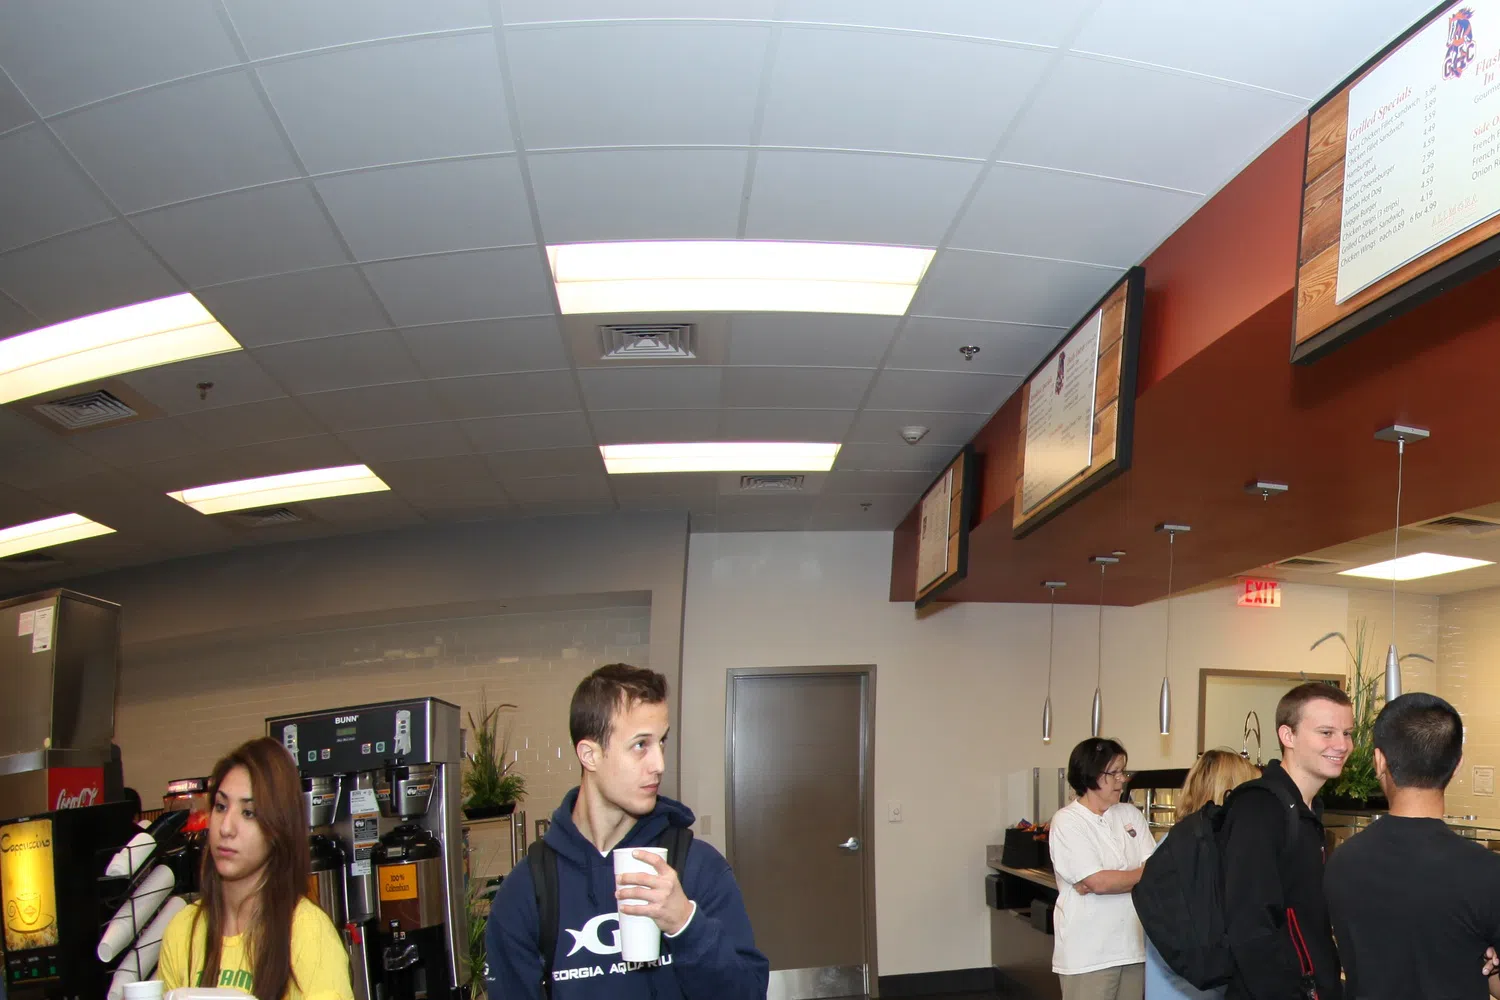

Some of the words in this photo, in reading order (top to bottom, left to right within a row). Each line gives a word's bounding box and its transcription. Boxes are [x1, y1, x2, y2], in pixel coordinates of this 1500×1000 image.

[1484, 72, 1495, 86] In
[1348, 144, 1361, 157] Spicy
[1360, 127, 1381, 146] Chicken
[1380, 117, 1394, 131] Fillet
[1394, 98, 1421, 119] Sandwich
[1349, 110, 1377, 141] Grilled
[1377, 86, 1412, 120] Specials
[1347, 156, 1374, 178] Hamburger
[1424, 110, 1436, 124] 3.59
[1472, 131, 1496, 153] French
[1473, 122, 1491, 138] Side
[1347, 150, 1366, 168] Chicken
[1366, 140, 1379, 154] Fillet
[1379, 121, 1405, 142] Sandwich
[1472, 146, 1496, 167] French
[1344, 190, 1360, 205] Bacon
[1360, 163, 1395, 194] Cheeseburger
[1422, 136, 1436, 149] 4.59
[1344, 201, 1361, 218] Jumbo
[1361, 192, 1371, 205] Hot
[1370, 186, 1383, 198] Dog
[1422, 149, 1435, 163] 2.99
[1345, 176, 1363, 192] Cheese
[1363, 164, 1378, 179] Steak
[1471, 163, 1493, 181] Onion
[1342, 224, 1362, 242] Chicken
[1362, 213, 1377, 229] Strips
[1376, 209, 1383, 220] (3
[1383, 197, 1400, 214] strips)
[1421, 176, 1434, 190] 4.59
[1343, 213, 1360, 229] Veggie
[1360, 201, 1378, 218] Burger
[1421, 162, 1435, 176] 4.29
[1340, 249, 1361, 268] Chicken
[1360, 240, 1377, 255] Wings
[1379, 230, 1393, 243] each
[1392, 220, 1405, 234] 0.89
[1409, 215, 1414, 224] 6
[1414, 210, 1424, 221] for
[1424, 200, 1437, 214] 4.99
[1341, 238, 1358, 255] Grilled
[1358, 226, 1378, 244] Chicken
[1378, 208, 1405, 229] Sandwich
[1420, 189, 1434, 203] 4.19
[1245, 580, 1277, 604] EXIT
[335, 714, 359, 724] BUNN
[0, 832, 51, 855] Cappuccino
[390, 874, 405, 882] 100%
[609, 953, 673, 975] AQUARIU
